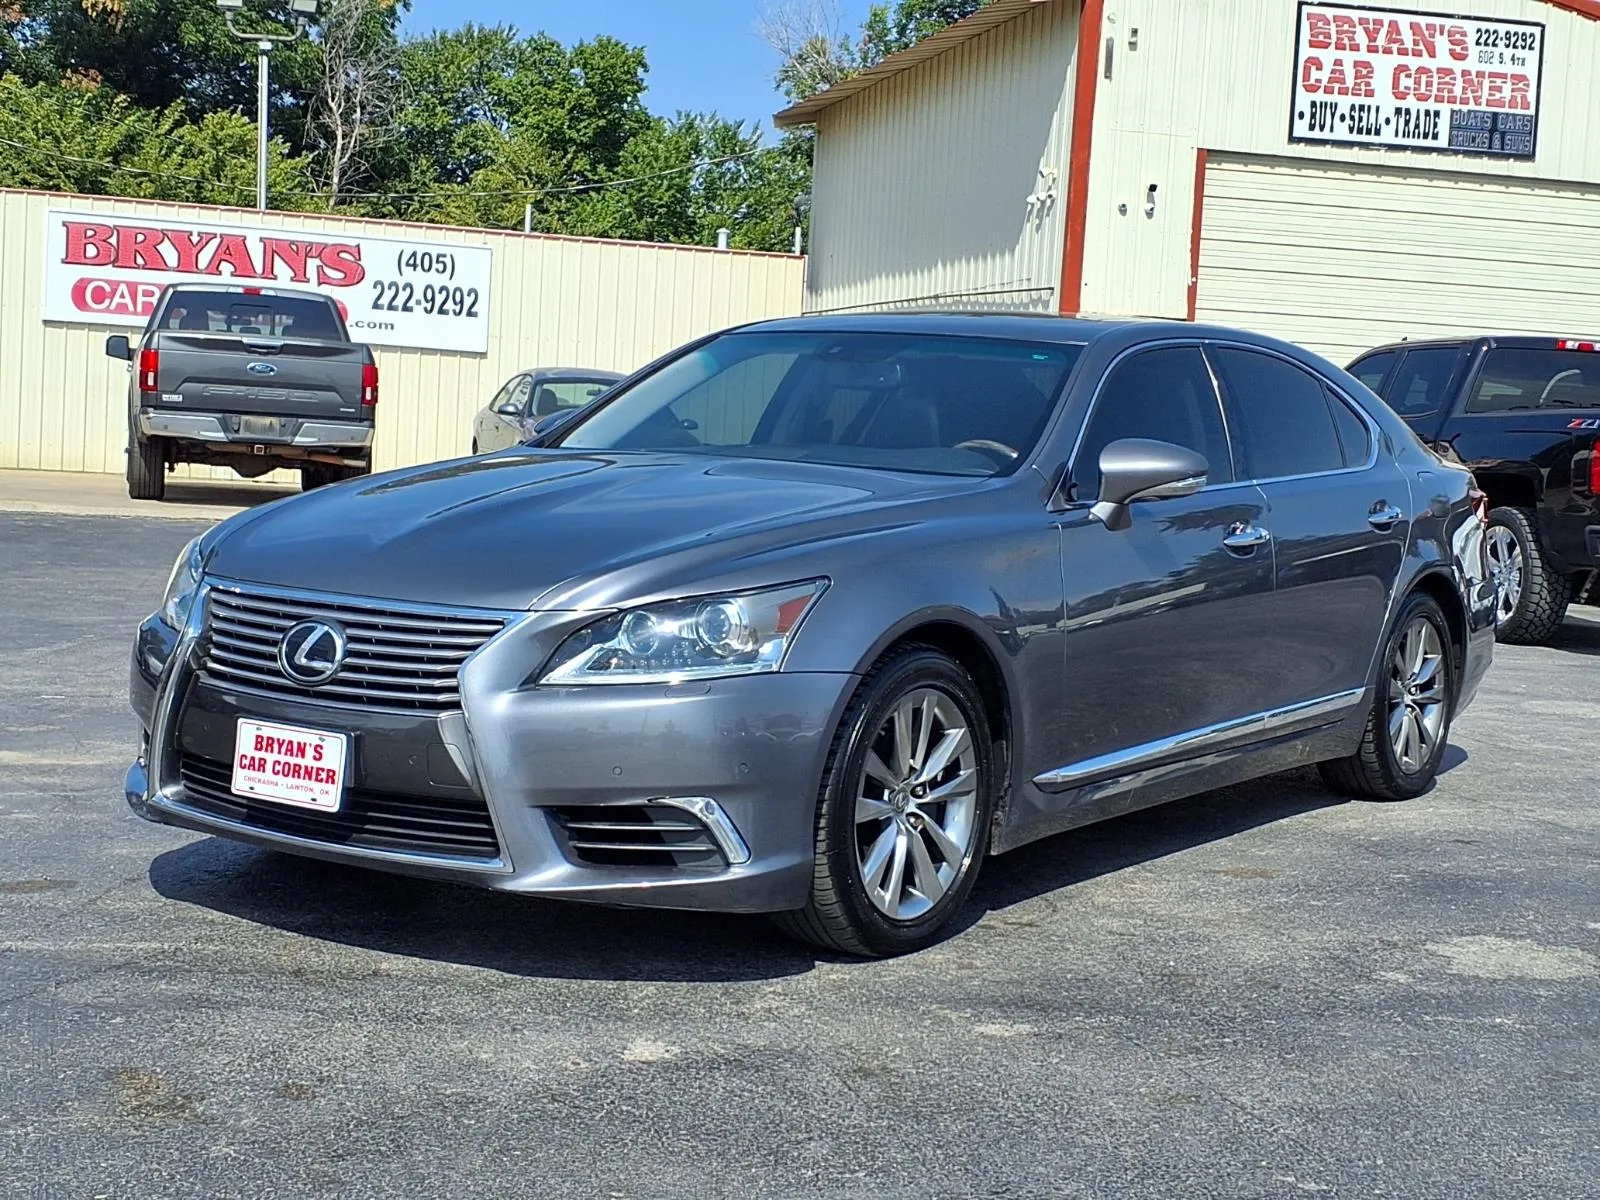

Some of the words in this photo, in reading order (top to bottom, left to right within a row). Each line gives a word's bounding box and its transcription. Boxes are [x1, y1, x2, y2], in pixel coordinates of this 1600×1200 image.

[1306, 12, 1470, 61] BRYAN'S
[1302, 56, 1375, 98] CAR
[1391, 63, 1531, 110] CORNER
[1348, 103, 1381, 136] SELL
[1394, 106, 1441, 140] TRADE
[1498, 113, 1532, 132] CARS
[1450, 130, 1490, 148] TRUCKS
[62, 221, 365, 287] BRYAN'S
[397, 249, 455, 280] (405)
[371, 280, 479, 318] 222-9292
[254, 734, 324, 761] BRYAN'S
[239, 754, 267, 773] CAR
[272, 760, 336, 785] CORNER
